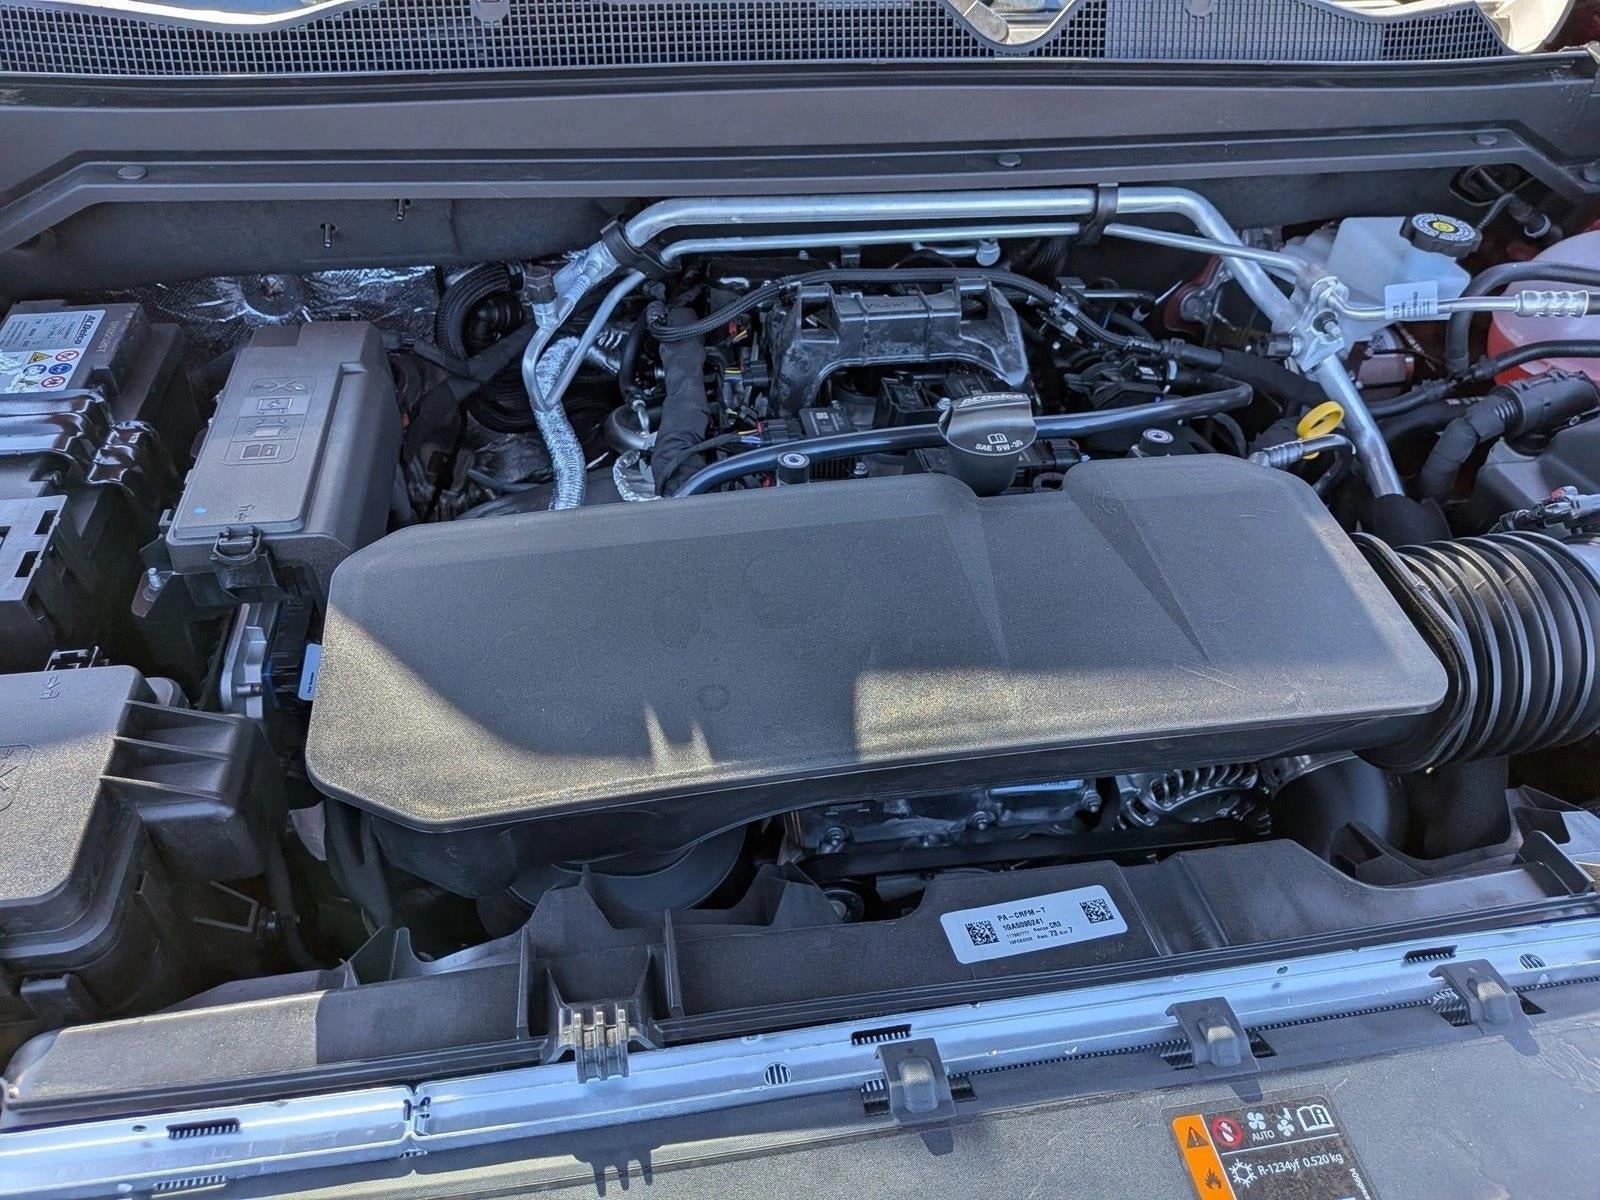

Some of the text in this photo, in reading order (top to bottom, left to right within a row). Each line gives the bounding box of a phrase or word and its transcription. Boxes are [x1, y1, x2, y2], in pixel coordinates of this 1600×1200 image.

[75, 314, 96, 345] ACDelco
[958, 393, 1024, 408] ACDelco
[975, 443, 993, 452] SAE
[1252, 1129, 1275, 1141] AUTO
[1257, 1152, 1344, 1176] R-1234yf 0.520 kg
